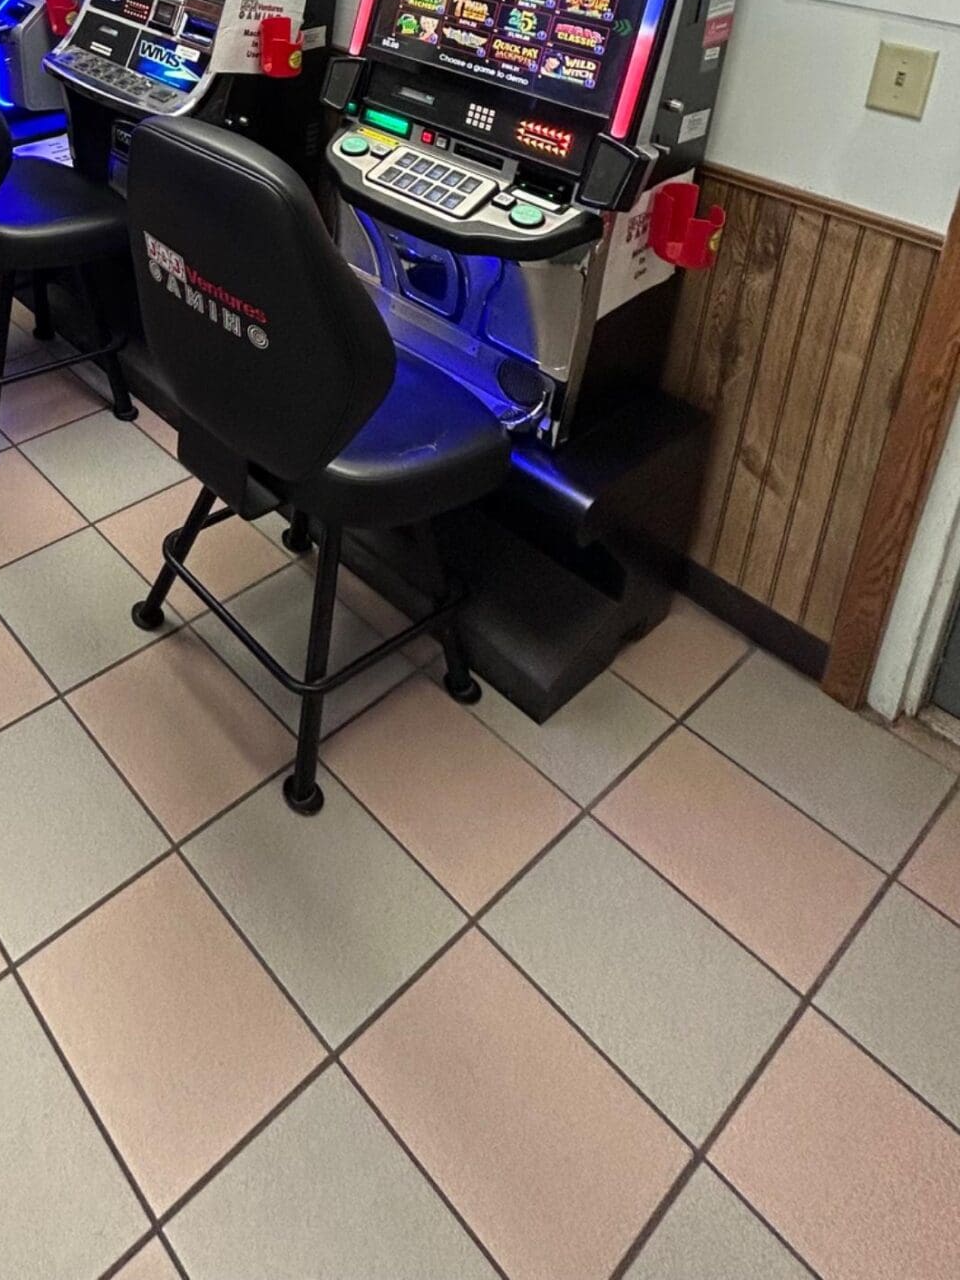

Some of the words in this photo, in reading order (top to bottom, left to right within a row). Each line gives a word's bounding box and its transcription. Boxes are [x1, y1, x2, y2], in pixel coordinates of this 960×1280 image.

[508, 7, 538, 33] 25
[493, 39, 521, 53] QUICK
[521, 46, 539, 59] PAY
[557, 31, 598, 48] CLASSIC
[139, 39, 183, 70] WMS
[564, 55, 597, 71] WILD
[439, 53, 466, 67] Choose
[473, 64, 496, 77] game
[497, 70, 505, 78] to
[505, 73, 529, 85] demo
[148, 258, 270, 350] GAMING
[185, 264, 267, 324] Ventures
